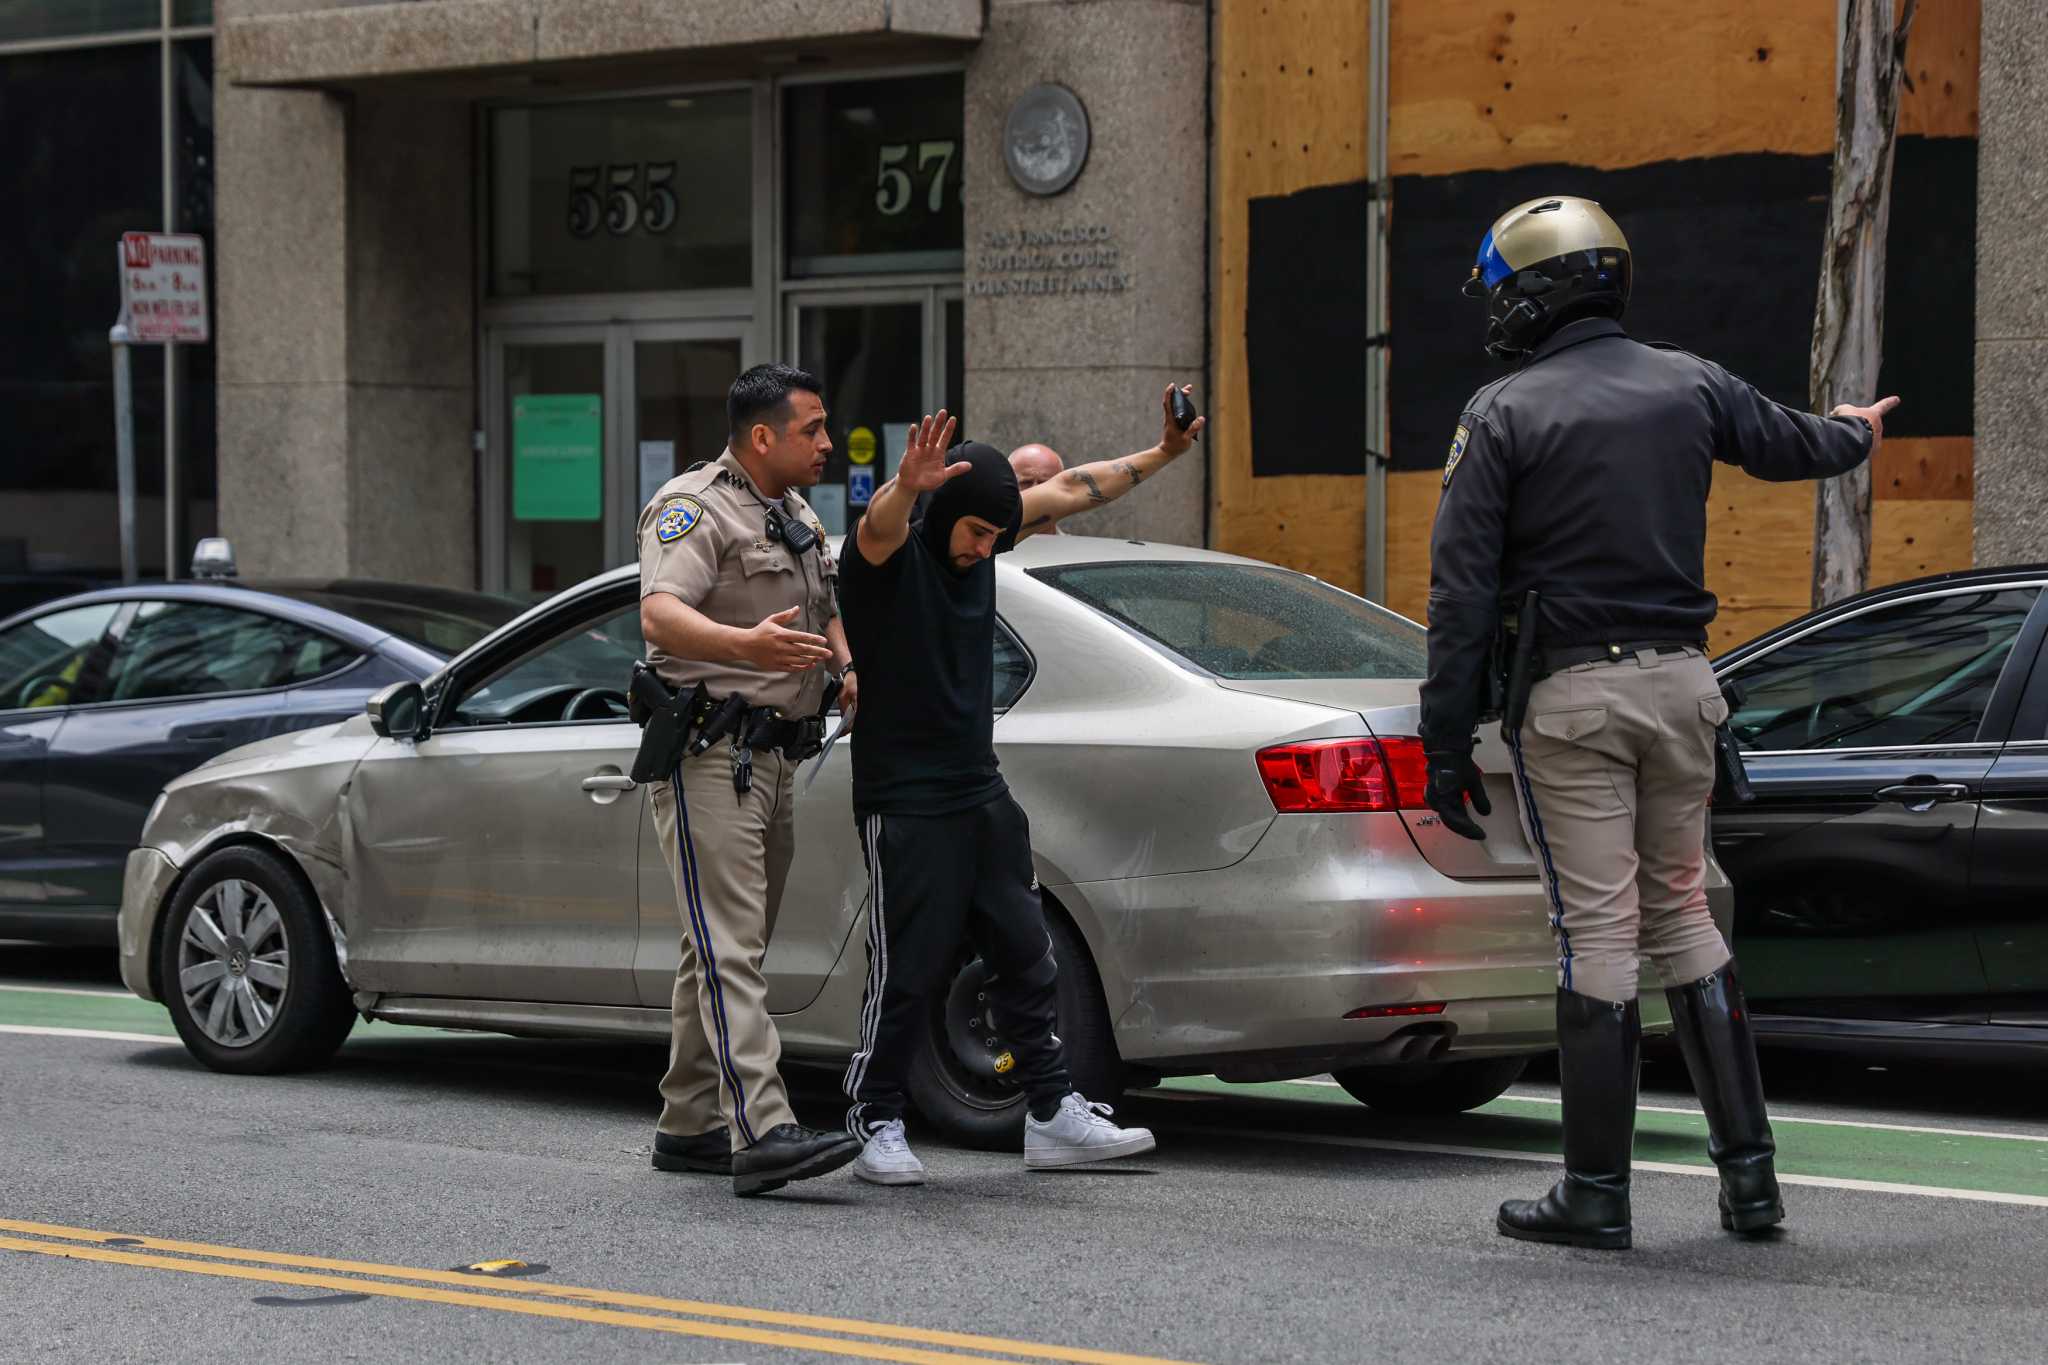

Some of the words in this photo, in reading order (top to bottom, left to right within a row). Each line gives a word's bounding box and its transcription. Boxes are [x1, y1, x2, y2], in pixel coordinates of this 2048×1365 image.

[876, 141, 965, 214] 57
[569, 162, 678, 236] 555
[1018, 225, 1111, 247] FRANCISCO
[126, 239, 150, 264] NO
[152, 245, 200, 265] PARKING
[1056, 248, 1119, 270] COURT
